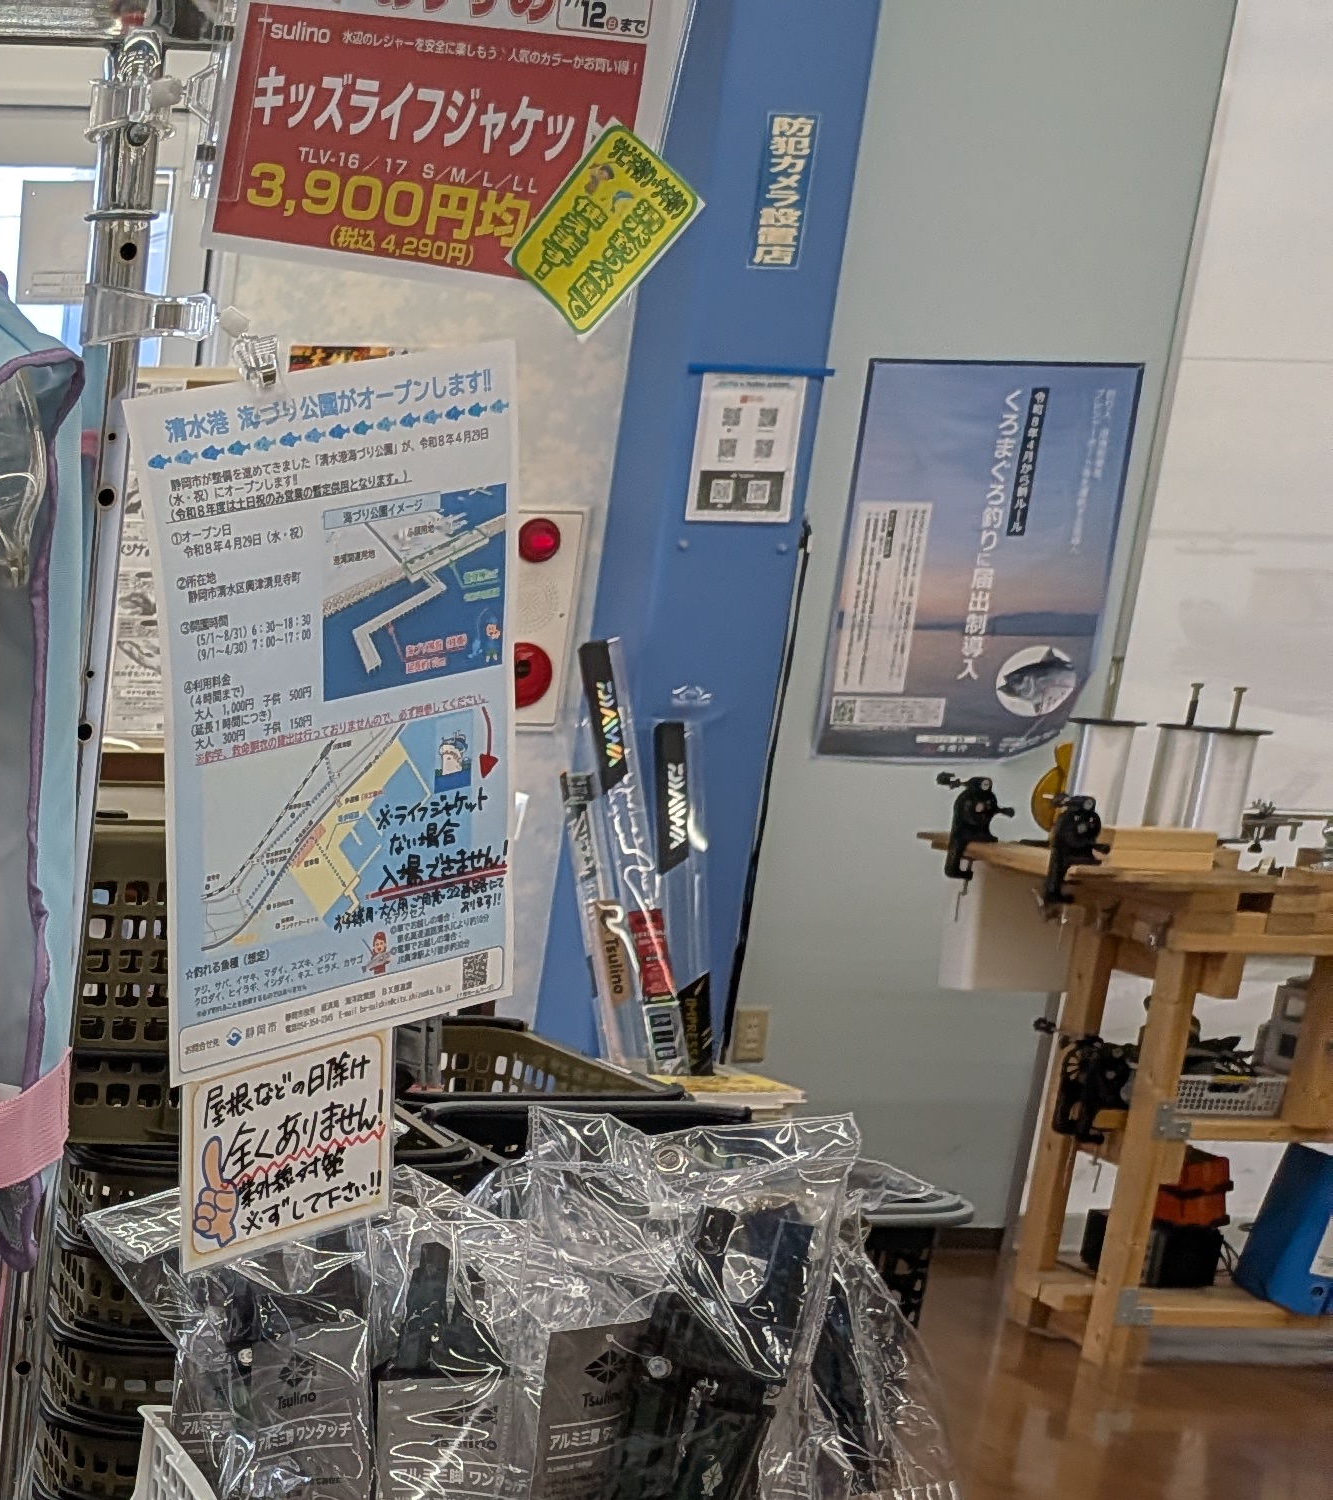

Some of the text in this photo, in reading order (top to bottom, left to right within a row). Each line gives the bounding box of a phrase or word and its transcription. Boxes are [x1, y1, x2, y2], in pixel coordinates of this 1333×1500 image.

[259, 15, 330, 44] Tsulino
[254, 66, 628, 161] キッズライフジャケット
[247, 162, 533, 248] 3,900円均
[754, 115, 816, 266] 防犯カメラ設置店
[165, 409, 231, 444] 清水港
[194, 706, 219, 722] 大人
[595, 679, 624, 768] DAIWA
[194, 736, 218, 752] 大人
[667, 762, 686, 850] DAIWA
[389, 822, 460, 856] ない場合
[604, 937, 625, 995] Tsulino
[244, 1021, 277, 1040] 静岡市
[203, 1051, 370, 1130] 屋根などの日除け
[278, 1390, 317, 1409] Tsulino
[295, 1421, 352, 1441] ワンタッチ
